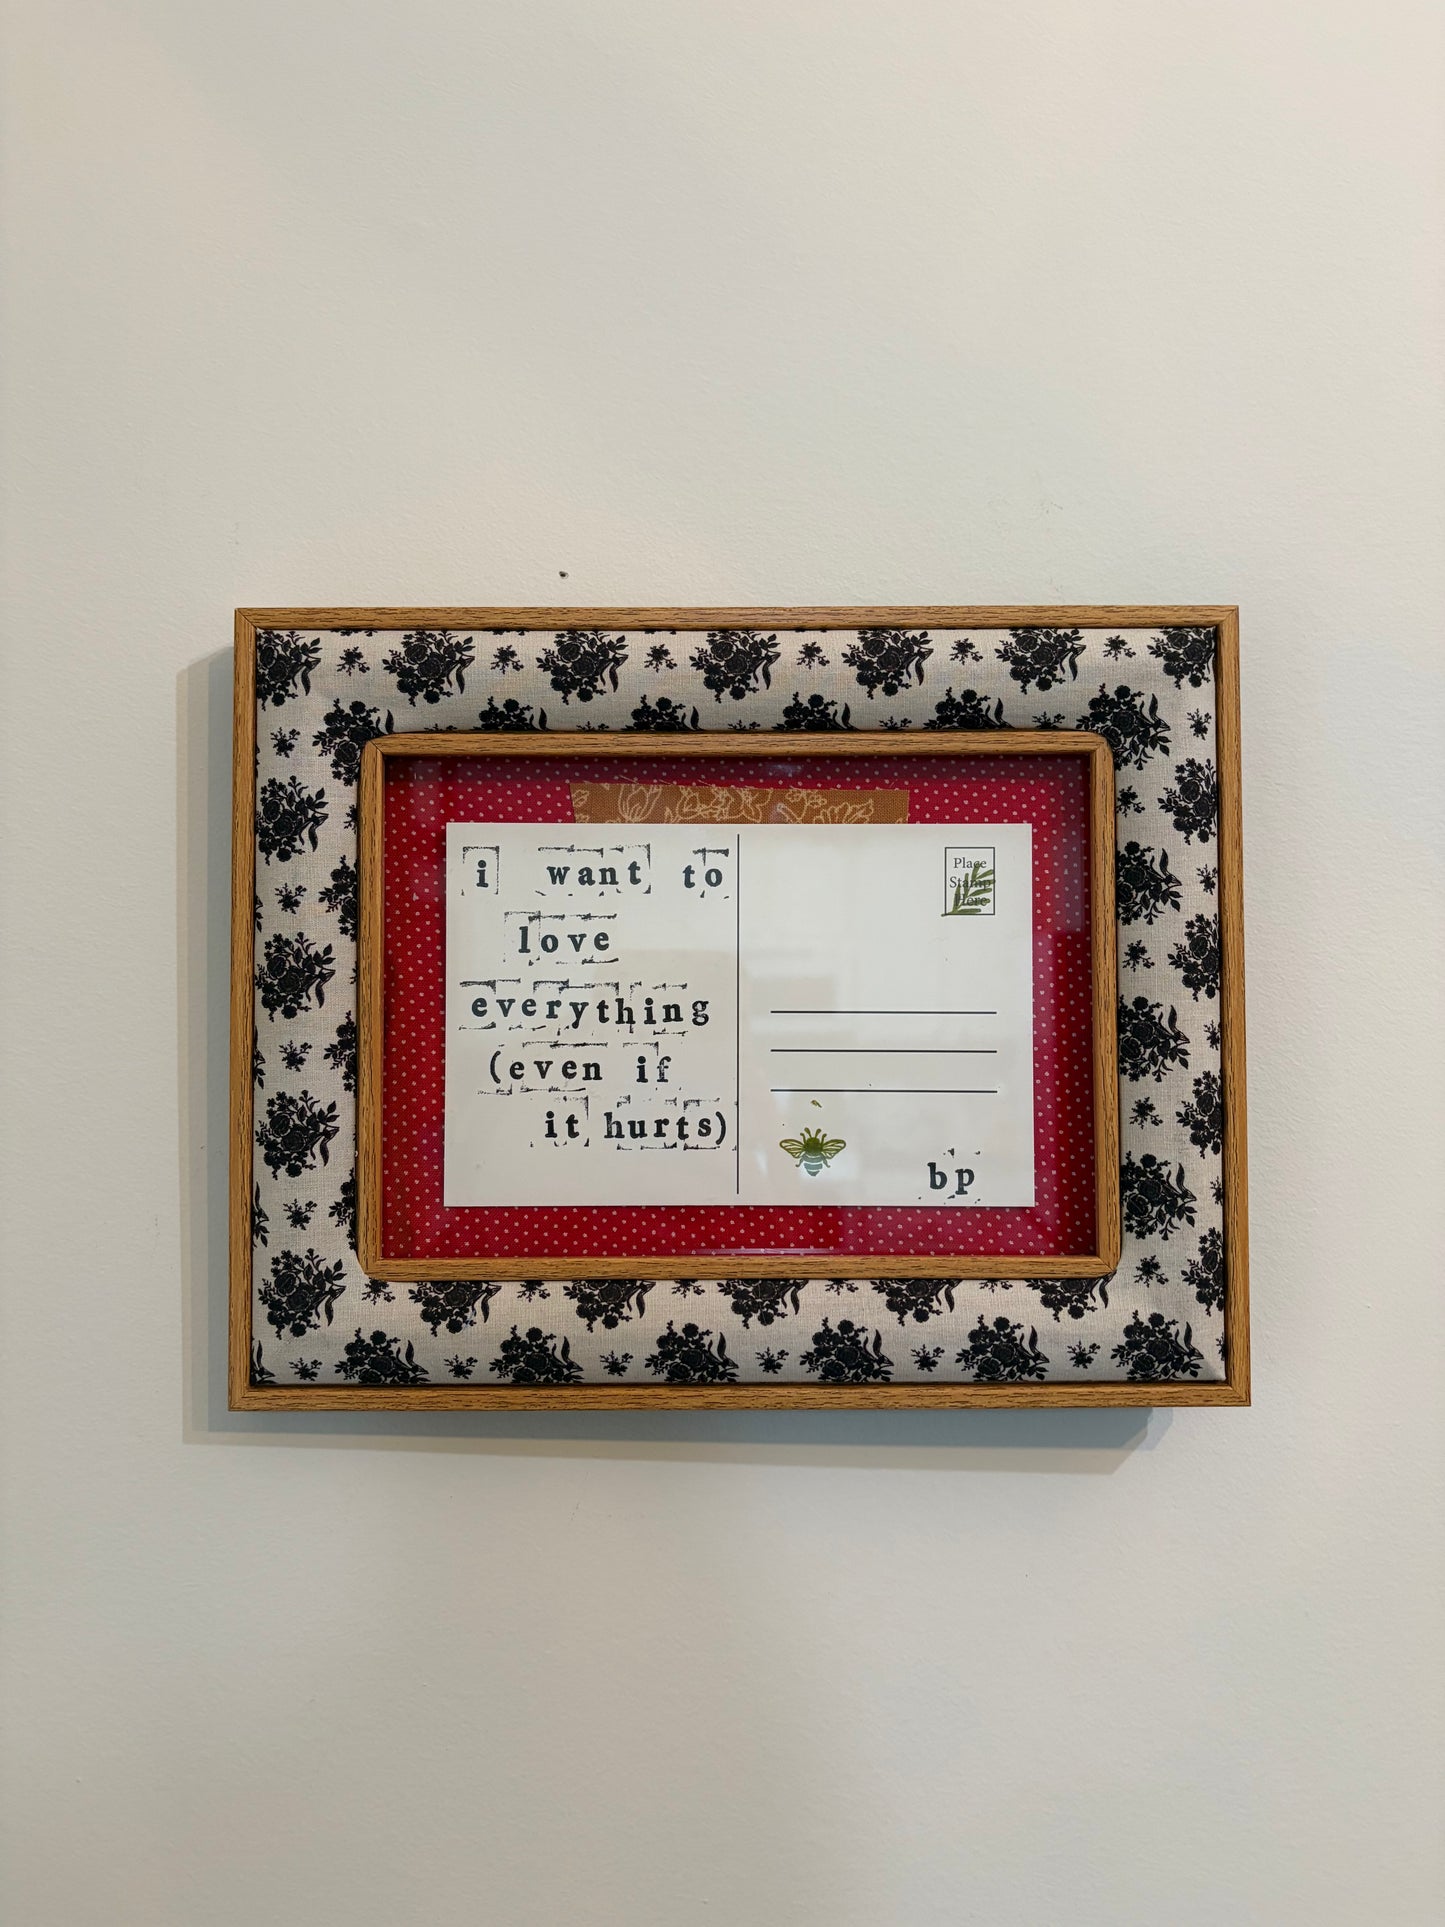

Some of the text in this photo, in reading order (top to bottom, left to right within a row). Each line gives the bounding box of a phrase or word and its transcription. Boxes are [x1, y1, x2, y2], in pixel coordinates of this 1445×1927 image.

[476, 860, 723, 889] i want to
[953, 857, 987, 869] Place
[518, 926, 610, 953] love
[471, 997, 709, 1029] everything
[490, 1051, 672, 1083] (even if
[544, 1111, 727, 1145] it hurts)
[927, 1162, 975, 1195] bp
